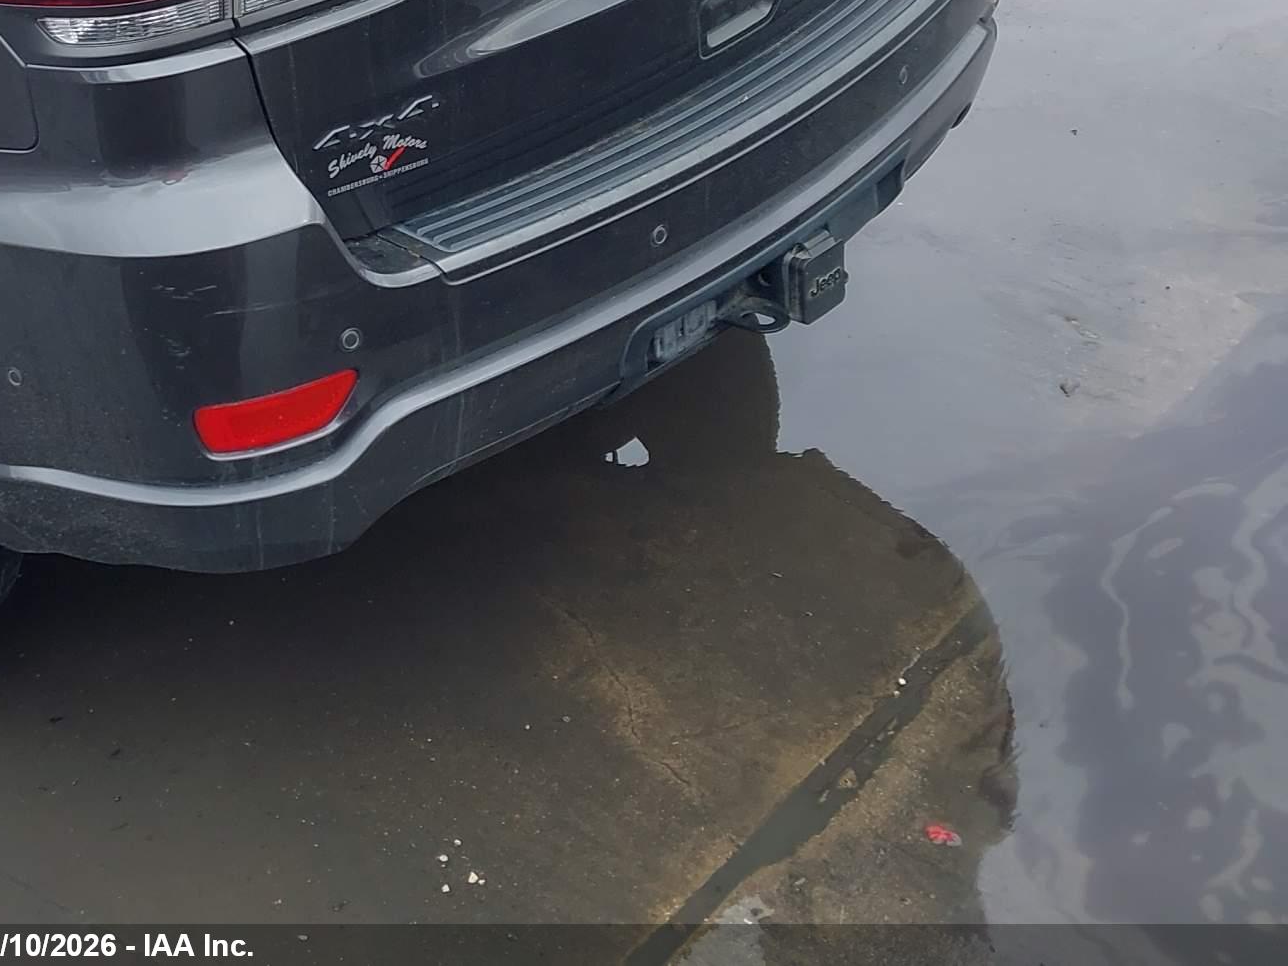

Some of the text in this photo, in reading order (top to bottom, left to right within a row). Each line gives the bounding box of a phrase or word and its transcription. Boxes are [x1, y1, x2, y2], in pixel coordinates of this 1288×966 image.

[327, 133, 428, 179] Shively Motors
[809, 266, 841, 298] Jeep
